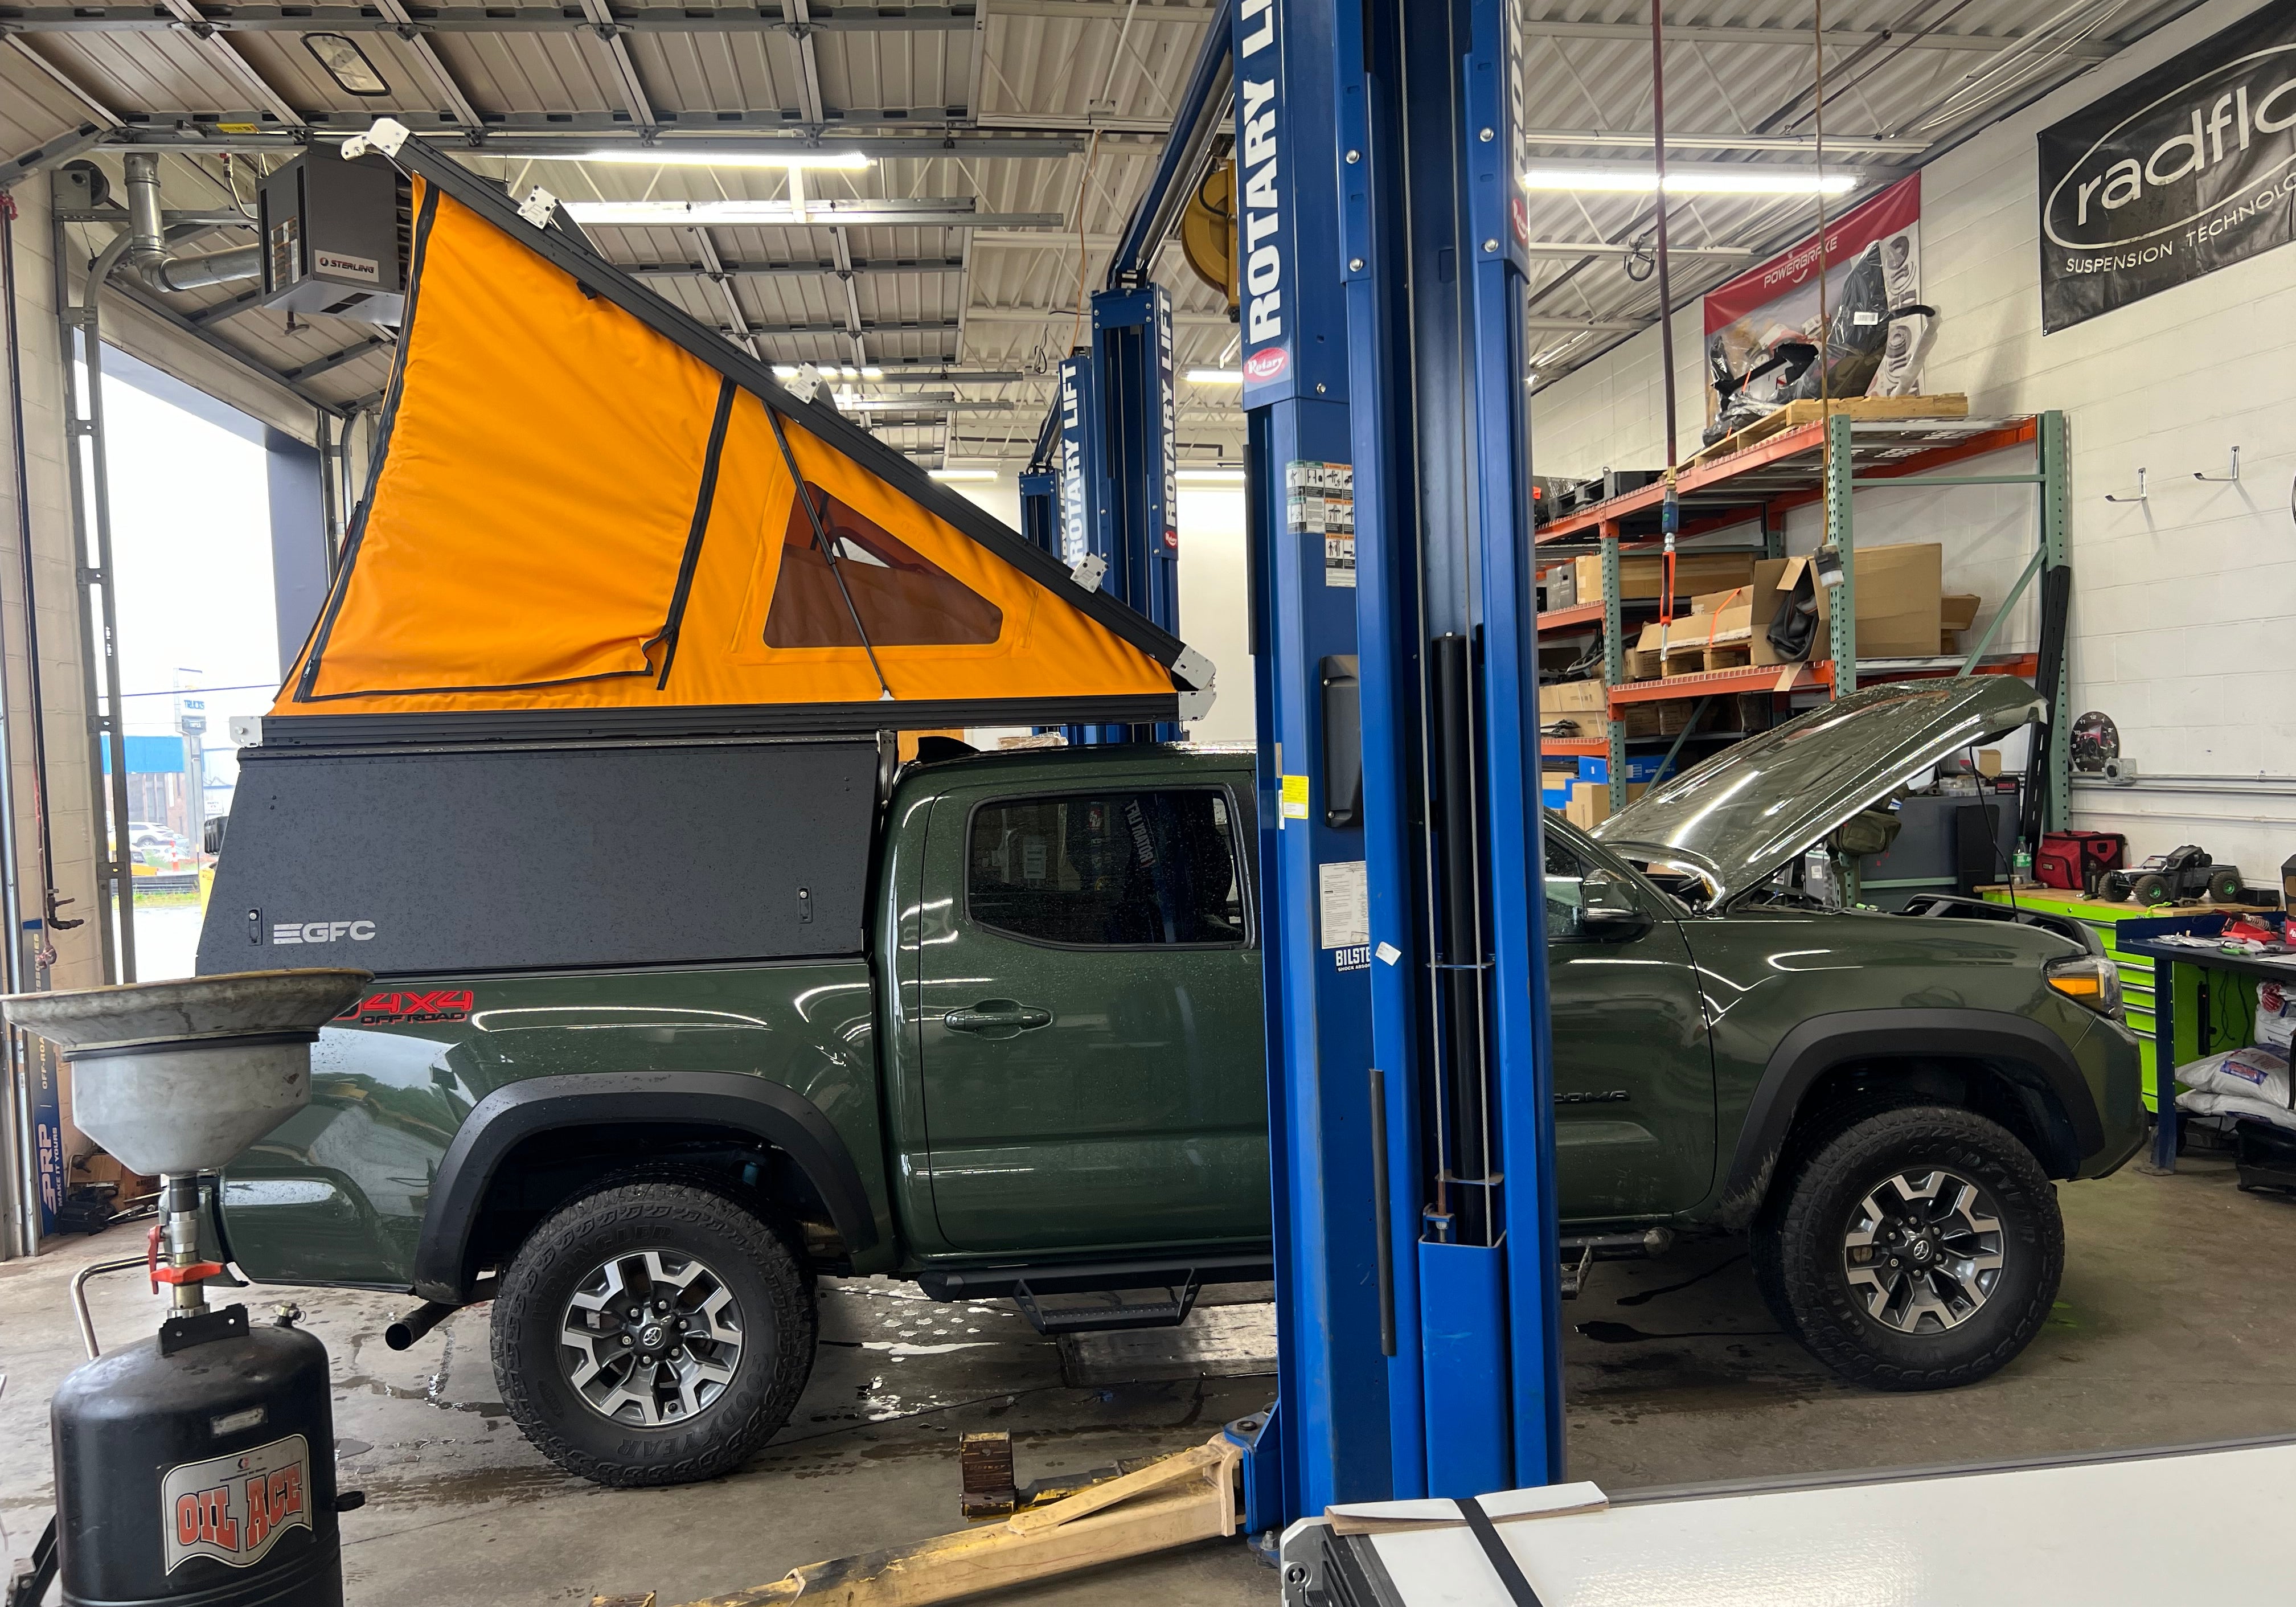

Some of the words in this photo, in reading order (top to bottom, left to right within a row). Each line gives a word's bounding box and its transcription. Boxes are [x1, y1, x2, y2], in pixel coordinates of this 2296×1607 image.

[1243, 79, 1281, 345] ROTARY
[330, 259, 375, 274] STERLING
[2066, 241, 2173, 274] SUSPENSION
[1159, 291, 1172, 371] LIFT
[1061, 363, 1079, 429] LIFT
[1248, 356, 1284, 377] Rotary
[1163, 379, 1176, 527] ROTARY
[1065, 439, 1083, 564] ROTARY
[360, 1014, 406, 1026] OFF
[407, 1012, 468, 1024] ROAD
[363, 990, 474, 1014] 4X4
[55, 1165, 60, 1175] IT
[531, 1225, 674, 1322] WRANGLER
[177, 1485, 239, 1552] OIL
[245, 1462, 303, 1552] ACE
